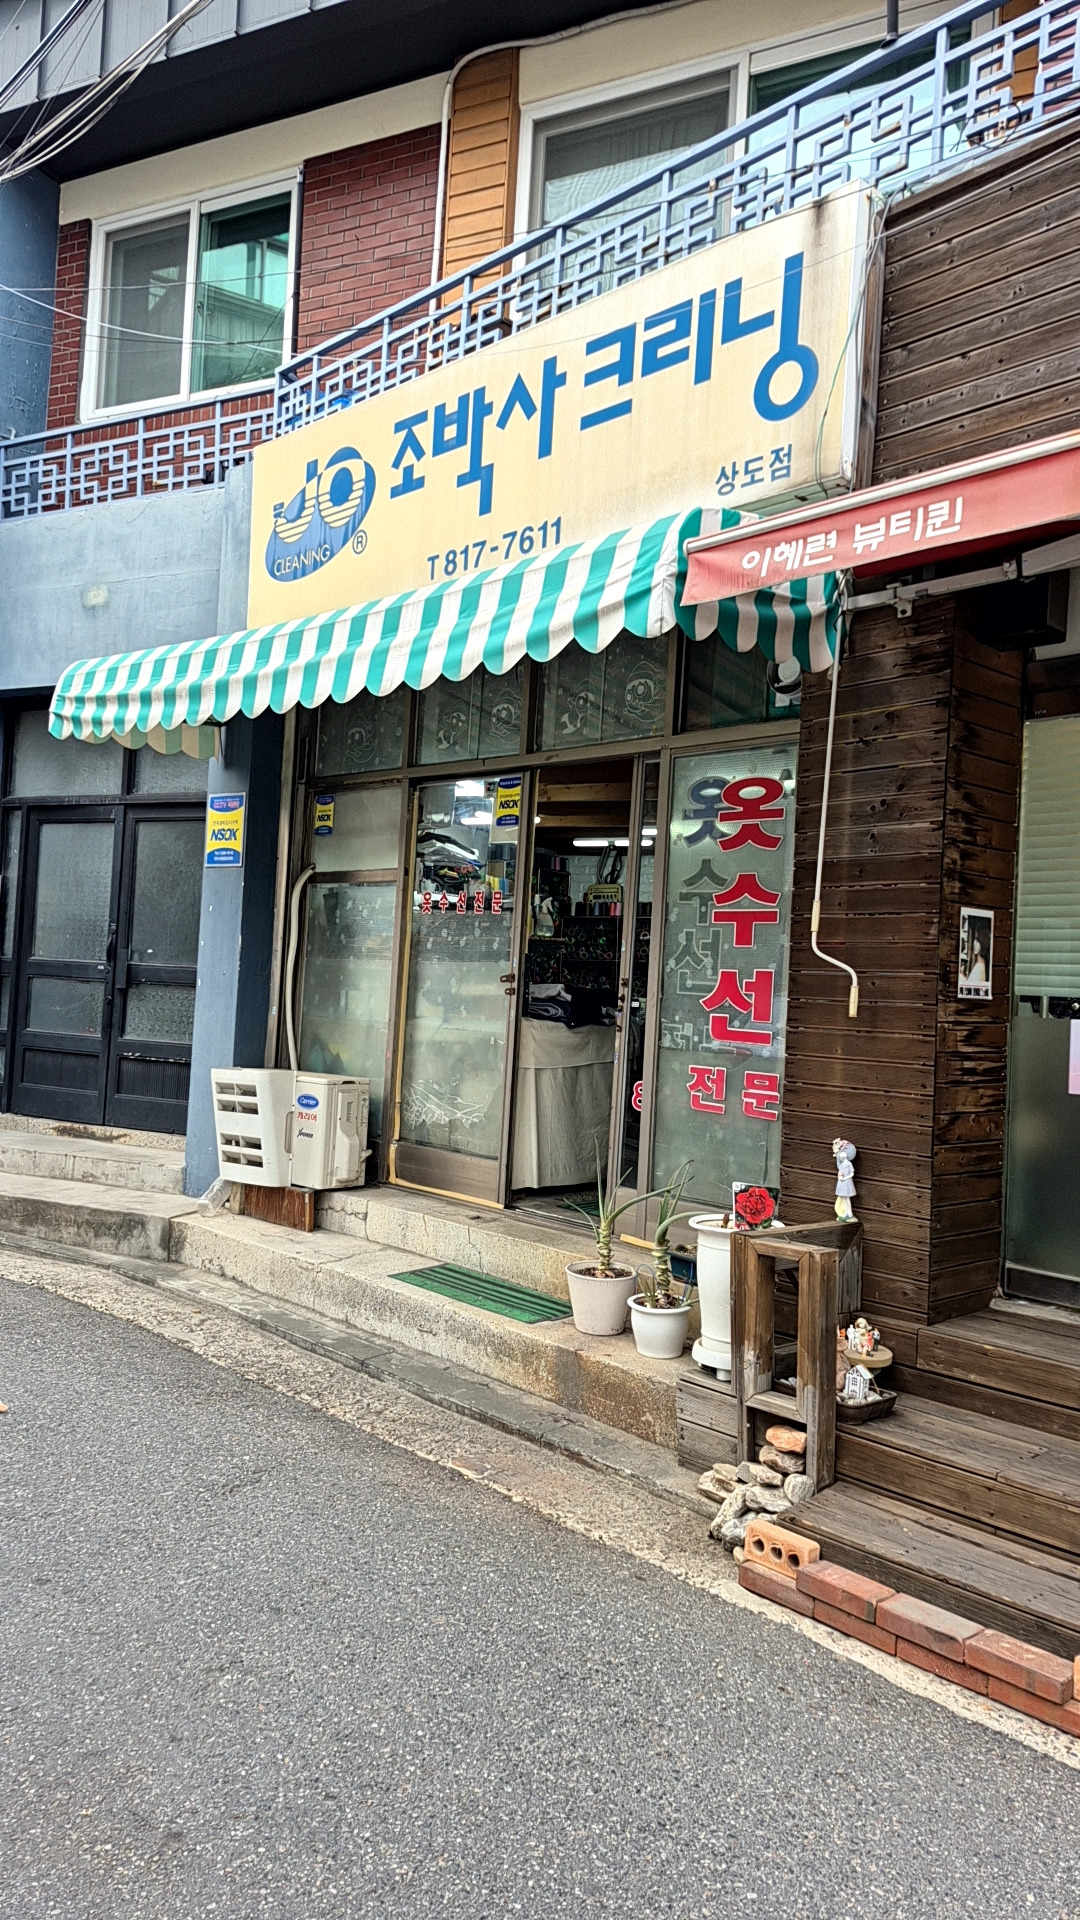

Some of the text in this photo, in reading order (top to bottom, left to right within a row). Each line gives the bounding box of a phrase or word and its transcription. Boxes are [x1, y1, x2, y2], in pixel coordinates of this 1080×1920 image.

[390, 251, 819, 517] 조박사 크리닝
[714, 443, 793, 497] 상도점
[741, 496, 964, 577] 이혜련 뷰티퀸
[273, 544, 331, 577] CLEANING
[499, 799, 520, 810] NSOK
[210, 828, 240, 842] NSOK
[299, 1097, 317, 1106] Carrier
[686, 1064, 780, 1121] 전문
[297, 1111, 317, 1122] 캐리어
